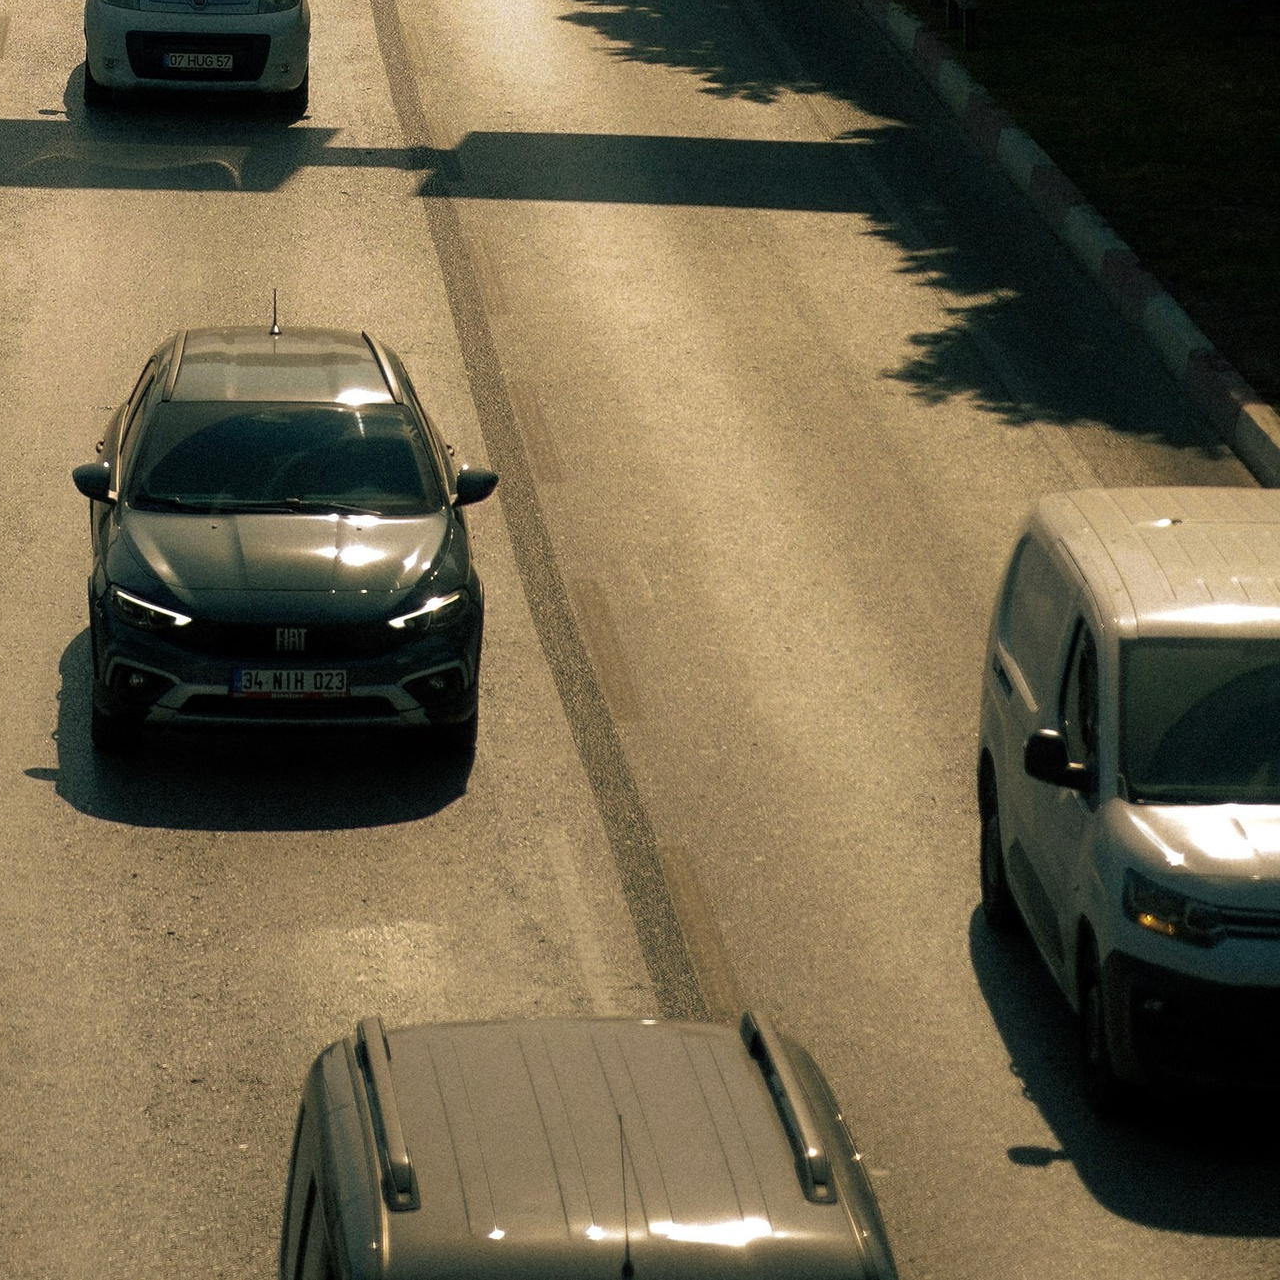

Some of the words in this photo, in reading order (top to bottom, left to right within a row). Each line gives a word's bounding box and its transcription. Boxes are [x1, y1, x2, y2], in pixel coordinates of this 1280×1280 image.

[170, 54, 185, 67] 07
[187, 55, 214, 67] HUG
[217, 55, 232, 67] 57
[276, 627, 308, 651] FIAT
[243, 671, 263, 690] 34
[272, 672, 305, 690] NIH
[313, 672, 346, 690] 023
